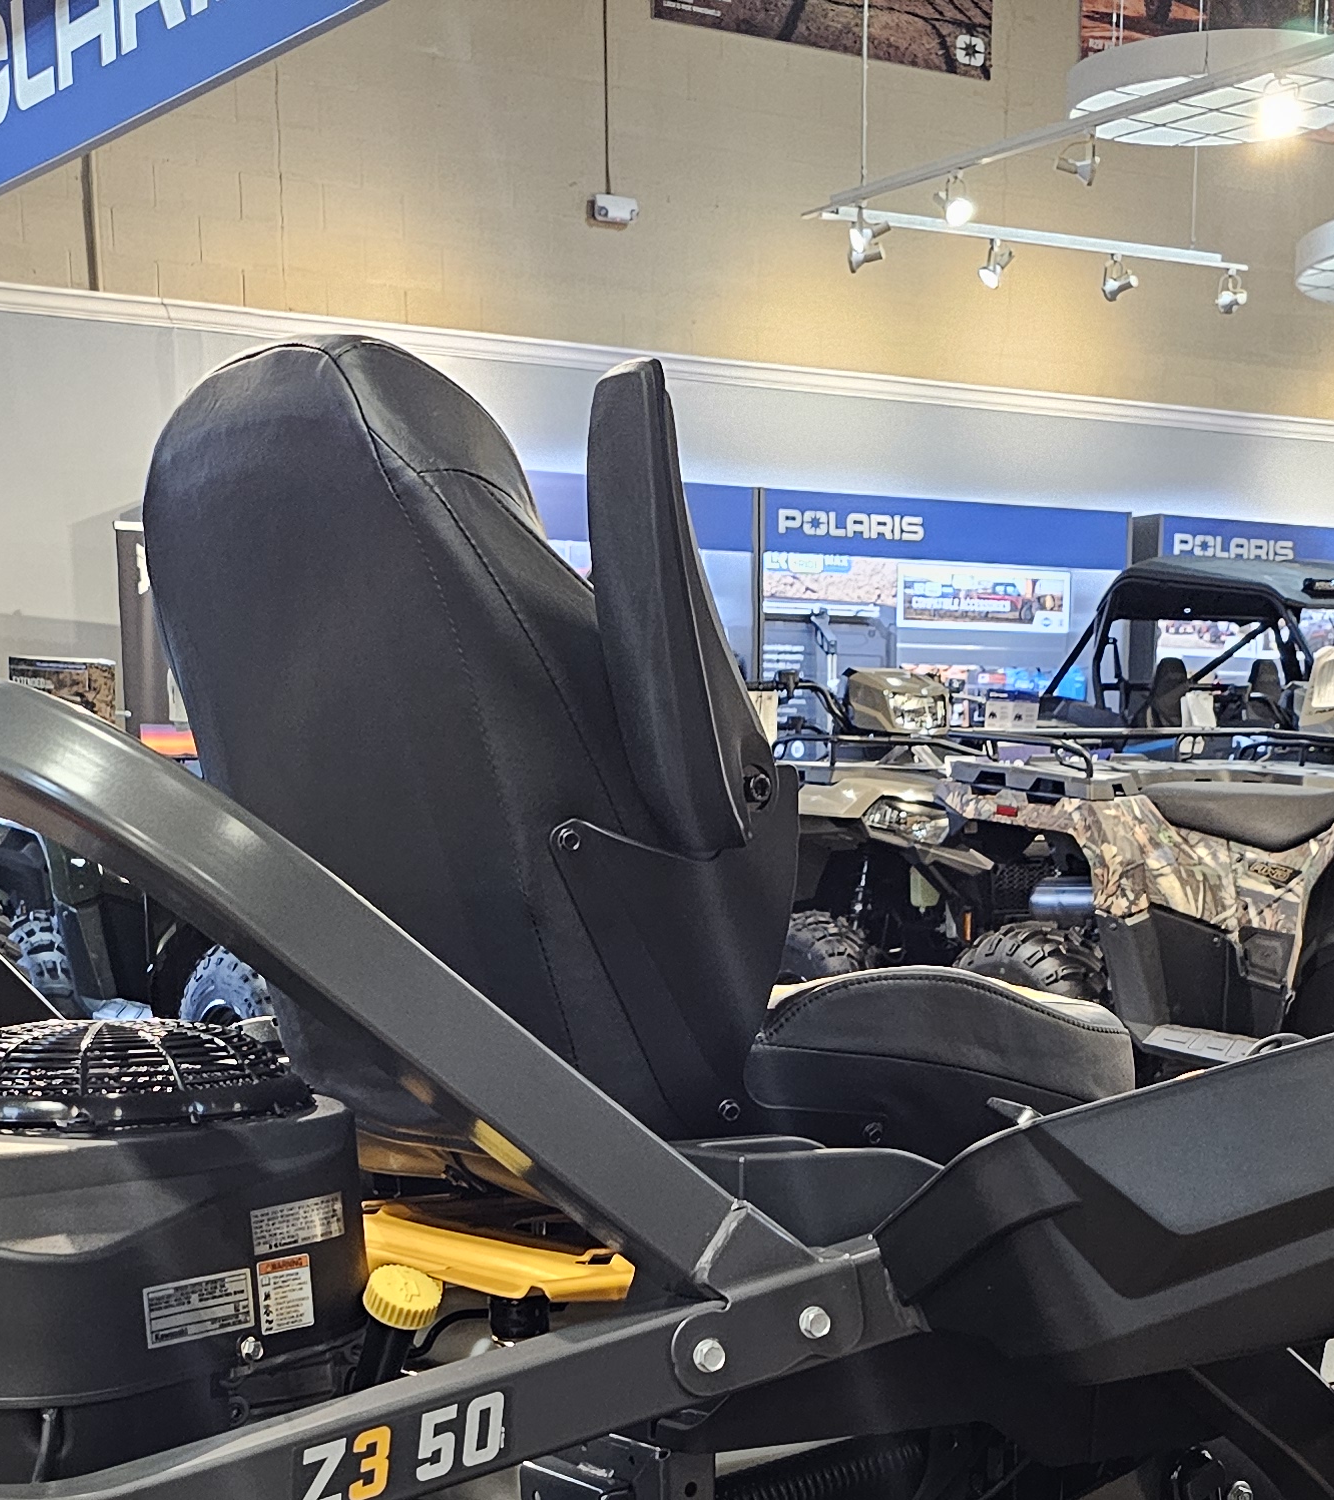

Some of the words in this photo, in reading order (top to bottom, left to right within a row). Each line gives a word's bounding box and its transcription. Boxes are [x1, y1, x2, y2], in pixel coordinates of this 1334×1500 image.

[778, 508, 925, 541] POLARIS
[1173, 532, 1294, 562] POLARIS
[416, 1391, 505, 1481] 50
